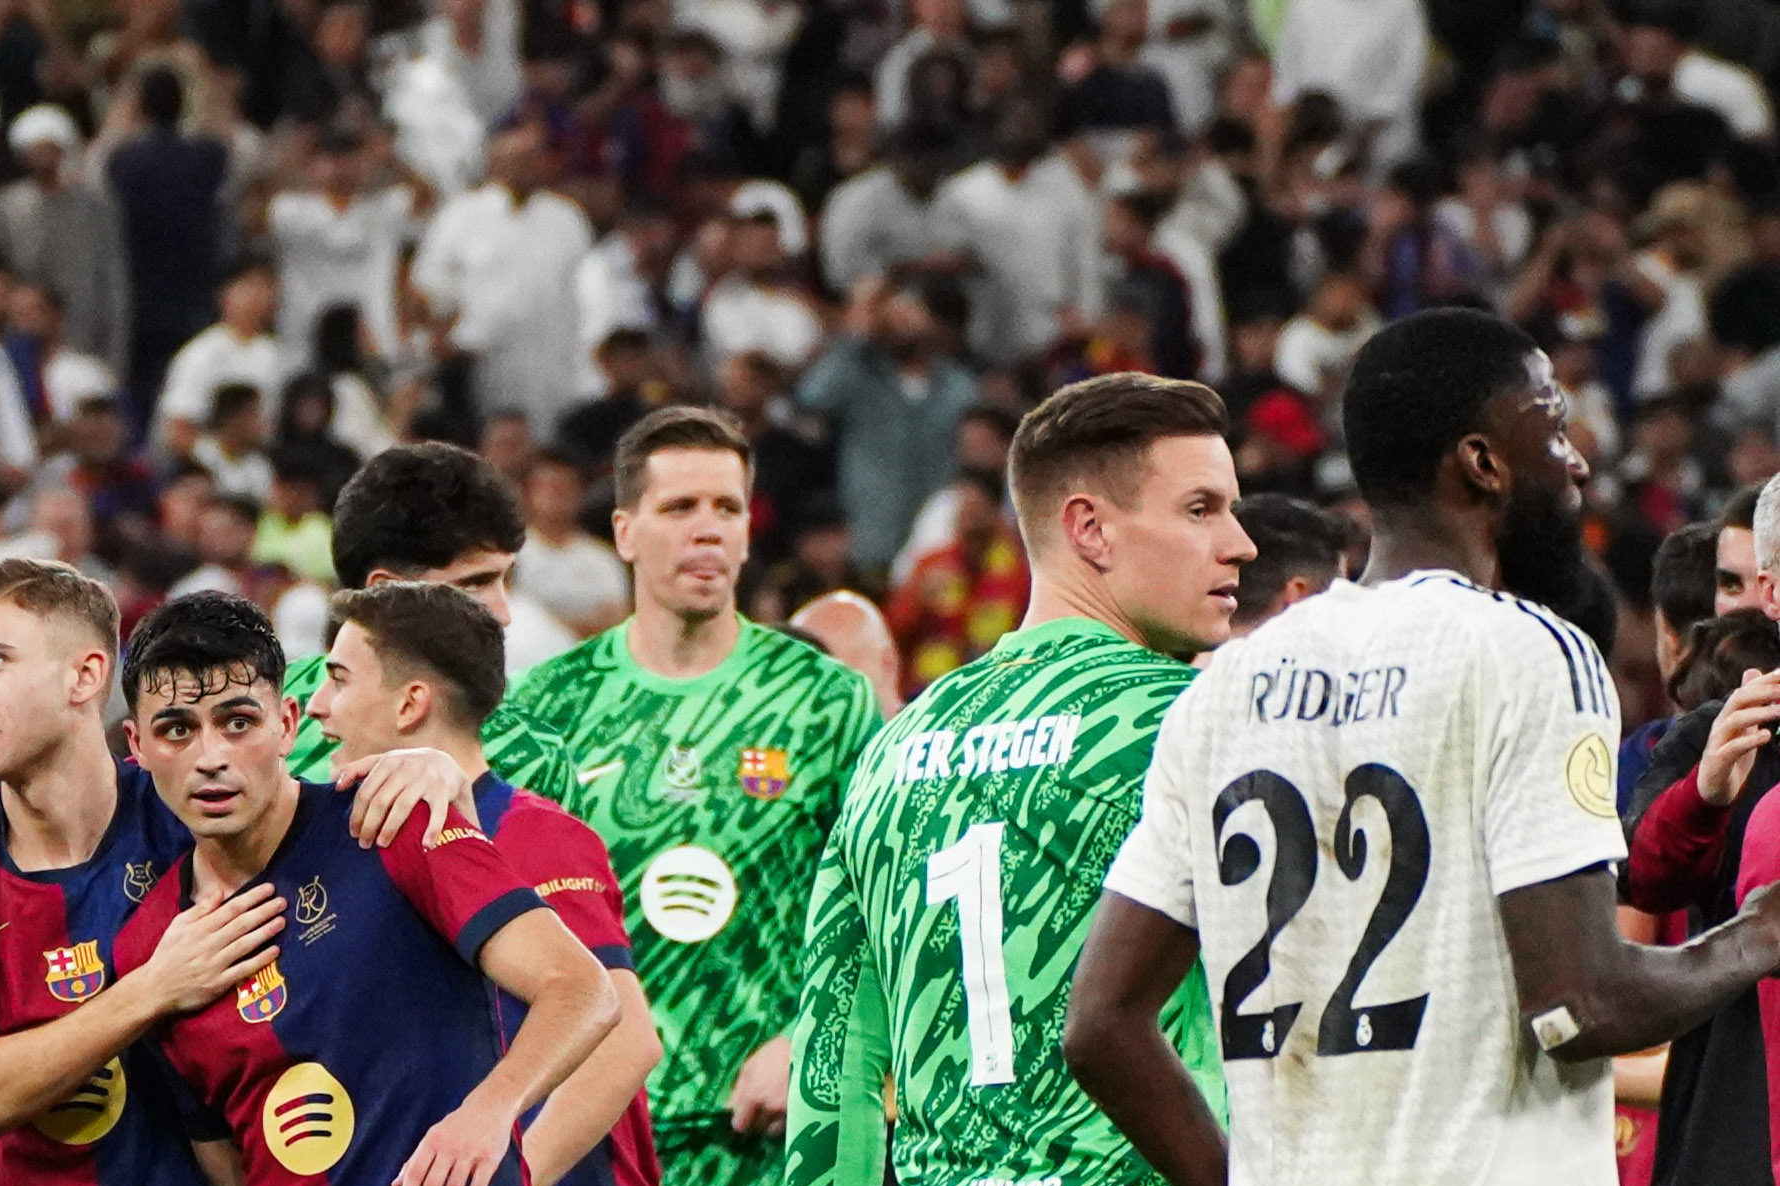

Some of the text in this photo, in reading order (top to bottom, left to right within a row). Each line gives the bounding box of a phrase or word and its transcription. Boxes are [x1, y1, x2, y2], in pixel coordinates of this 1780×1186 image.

[894, 714, 1081, 785] TER STEGEN
[926, 822, 1018, 1087] 1
[1212, 762, 1431, 1061] 22
